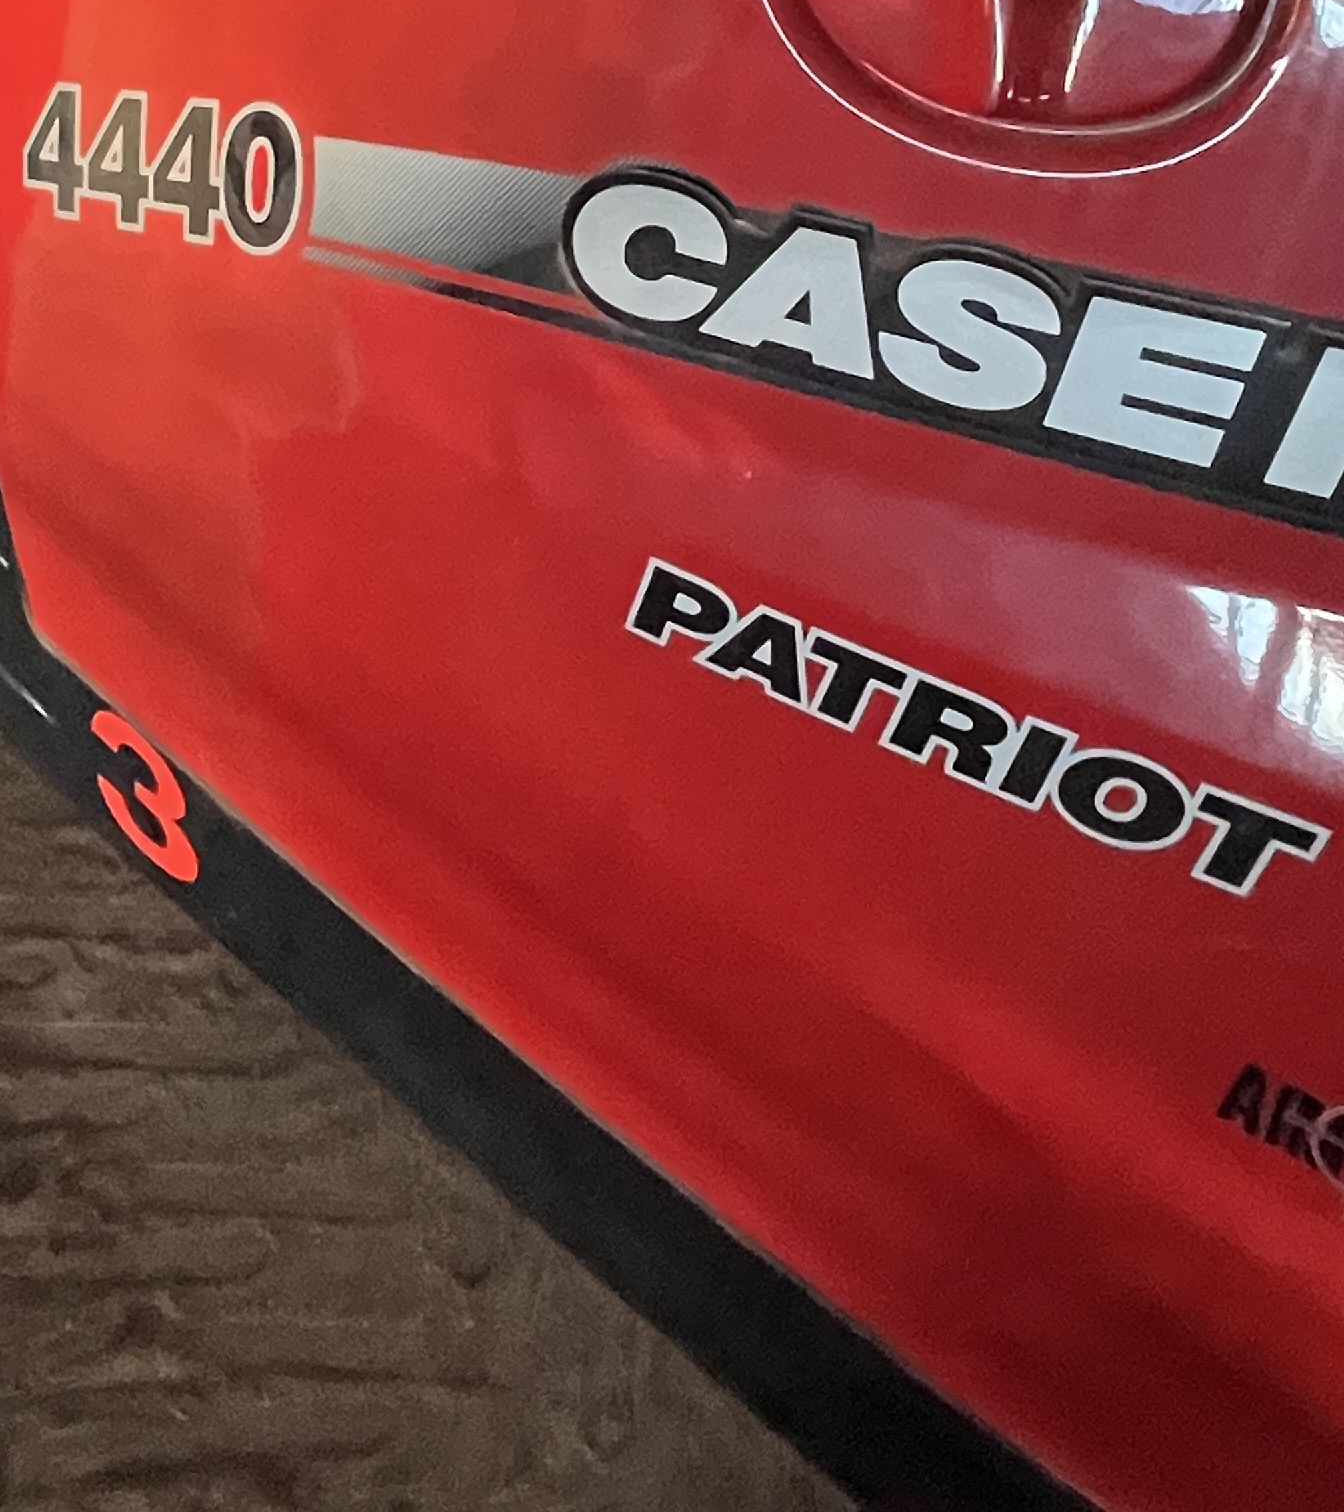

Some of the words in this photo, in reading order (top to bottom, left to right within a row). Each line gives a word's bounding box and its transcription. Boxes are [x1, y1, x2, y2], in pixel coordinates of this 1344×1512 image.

[22, 81, 303, 256] 4440
[570, 182, 1271, 470] CASE
[90, 710, 198, 884] 3
[624, 555, 1335, 899] PATRIOT
